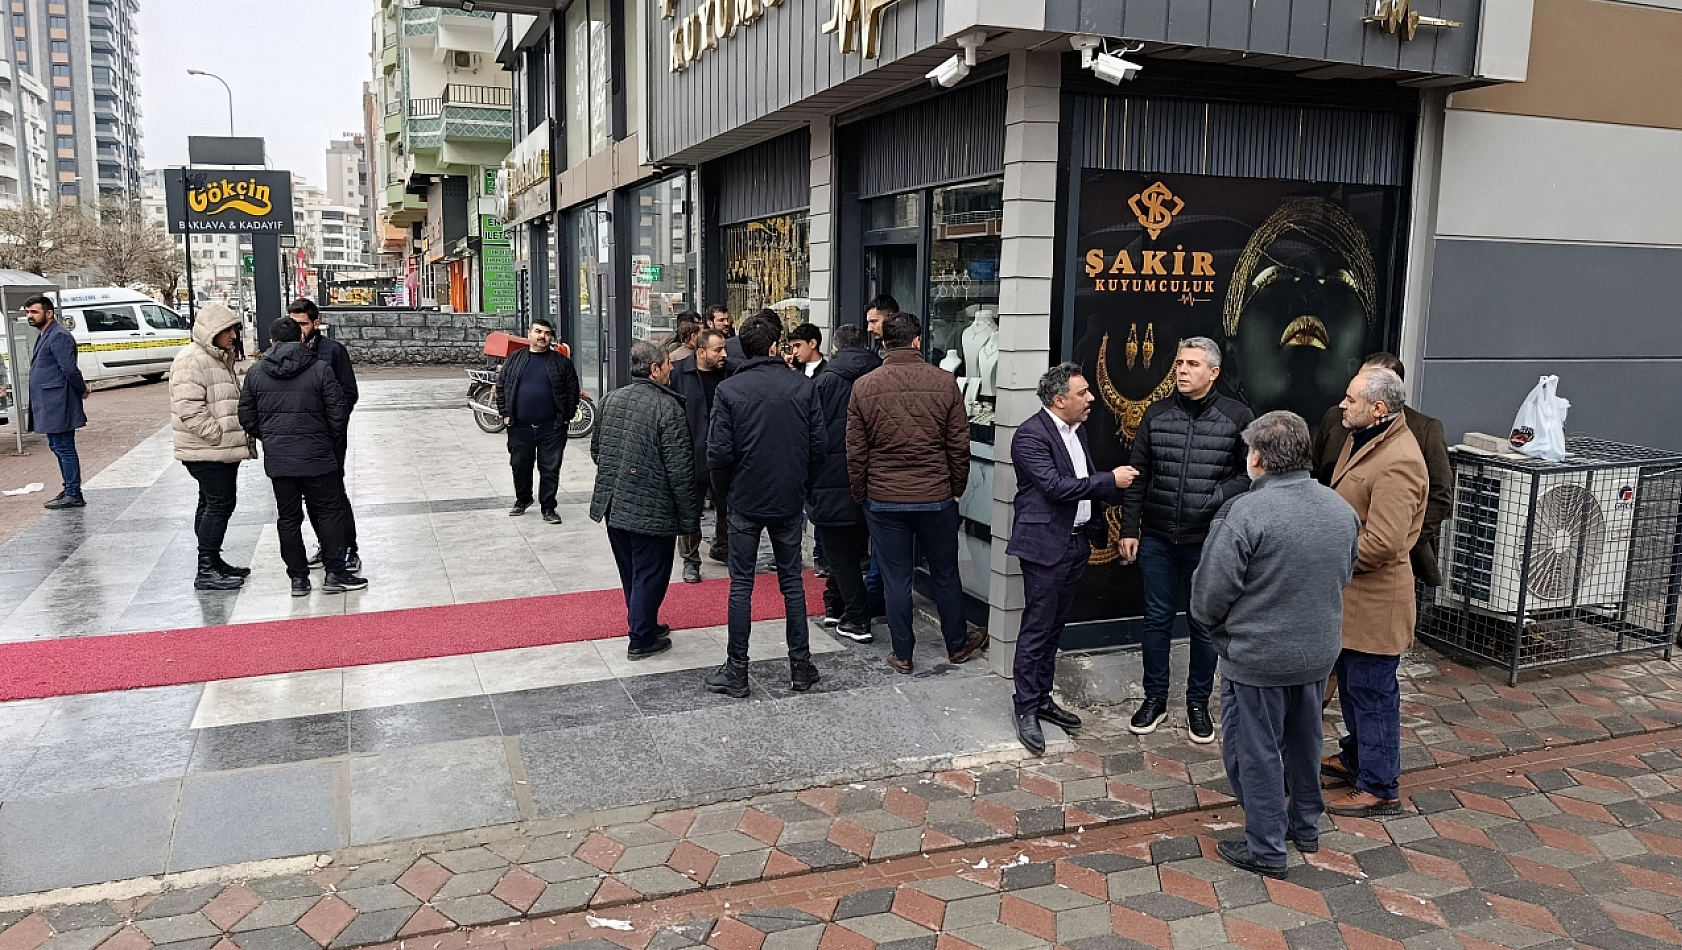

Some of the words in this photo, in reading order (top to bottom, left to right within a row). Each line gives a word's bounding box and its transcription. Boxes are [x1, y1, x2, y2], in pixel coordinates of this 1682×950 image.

[189, 177, 272, 213] Gökçin
[178, 220, 227, 230] BAKLAVA
[229, 220, 237, 230] &
[239, 220, 284, 230] KADAYIF
[1085, 243, 1216, 278] ŞAKİR
[1094, 279, 1215, 293] KUYUMCULUK
